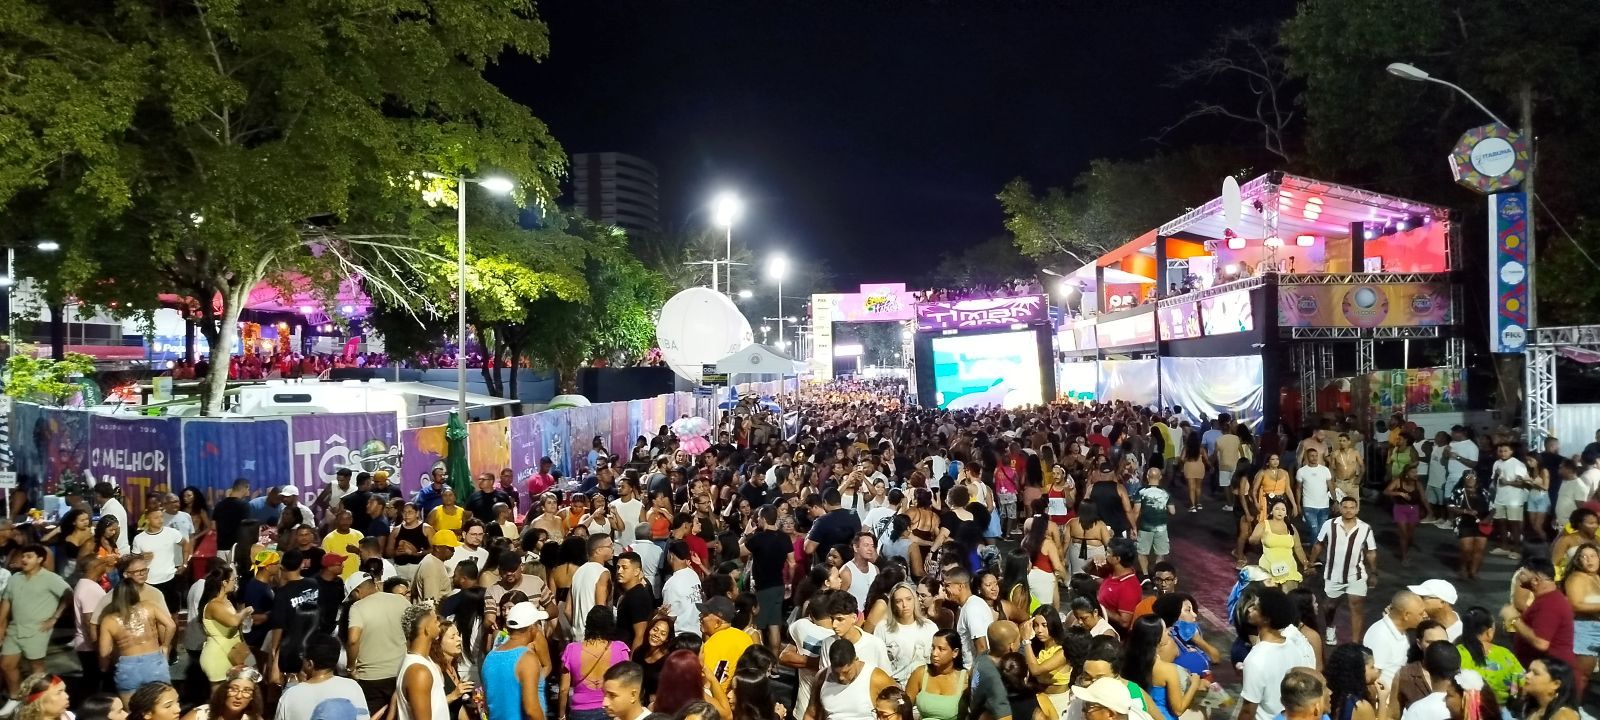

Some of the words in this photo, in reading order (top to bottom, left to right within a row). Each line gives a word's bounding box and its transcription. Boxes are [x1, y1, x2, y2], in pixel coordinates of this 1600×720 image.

[1482, 148, 1512, 159] ITABUNA
[92, 447, 100, 467] O
[102, 447, 166, 472] MELHOR
[294, 433, 350, 487] TÔ
